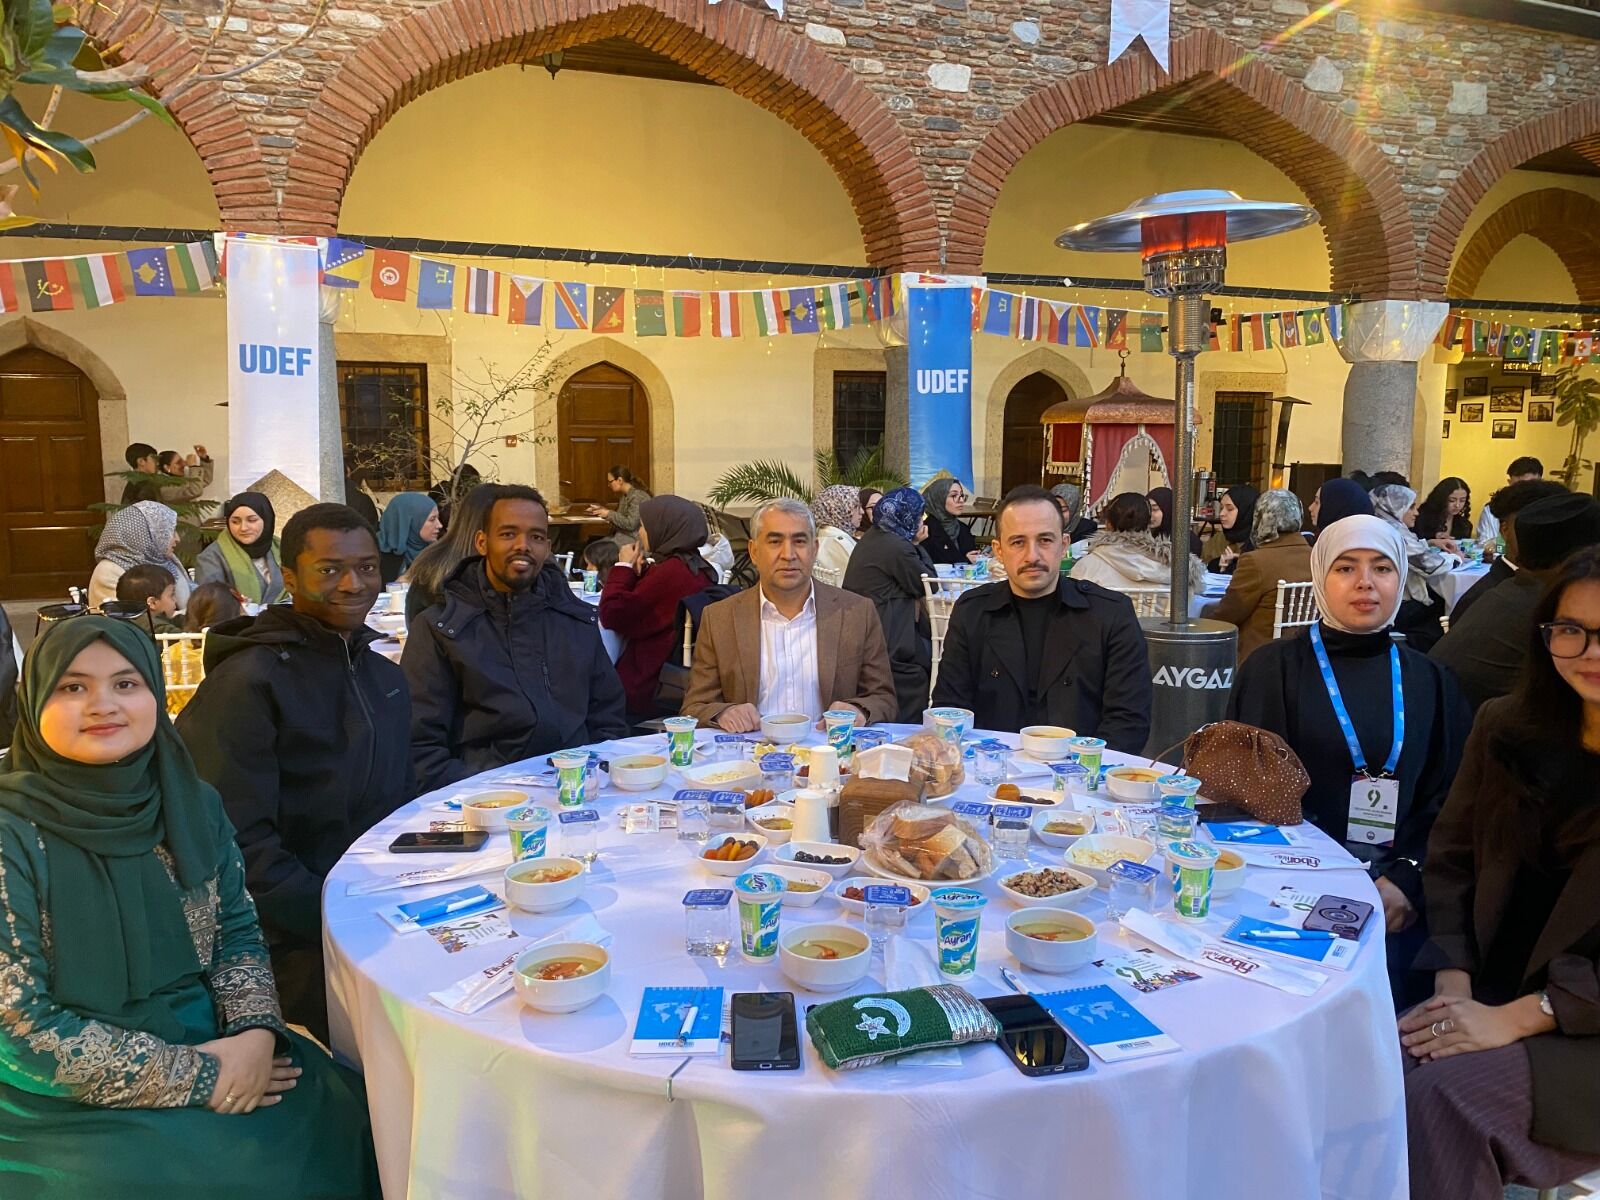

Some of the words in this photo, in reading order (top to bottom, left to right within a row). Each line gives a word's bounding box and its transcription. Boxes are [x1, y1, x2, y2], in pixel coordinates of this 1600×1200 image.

[239, 343, 312, 376] UDEF
[916, 368, 969, 394] UDEF
[1152, 665, 1234, 690] AYGAZ
[943, 931, 973, 947] Ayran
